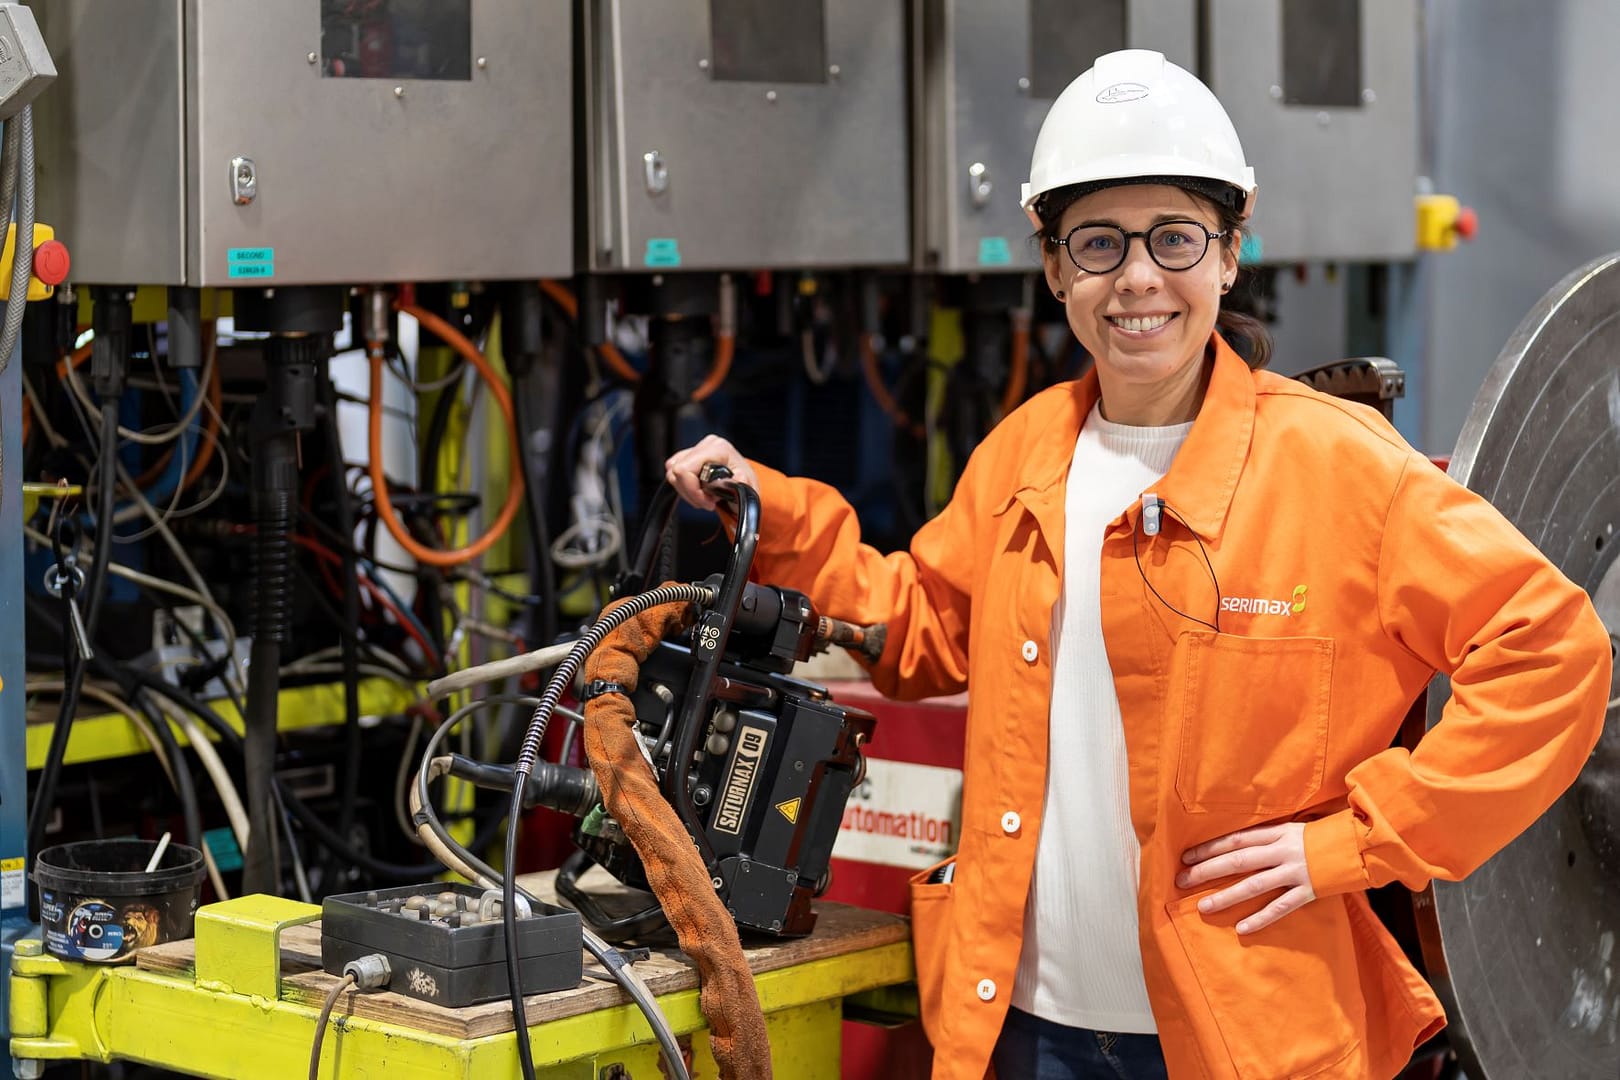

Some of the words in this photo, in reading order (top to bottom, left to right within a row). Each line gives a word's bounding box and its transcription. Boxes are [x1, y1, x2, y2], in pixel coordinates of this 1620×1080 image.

[720, 757, 756, 828] SATURNAX
[742, 731, 762, 753] 09
[841, 804, 953, 844] utomation
